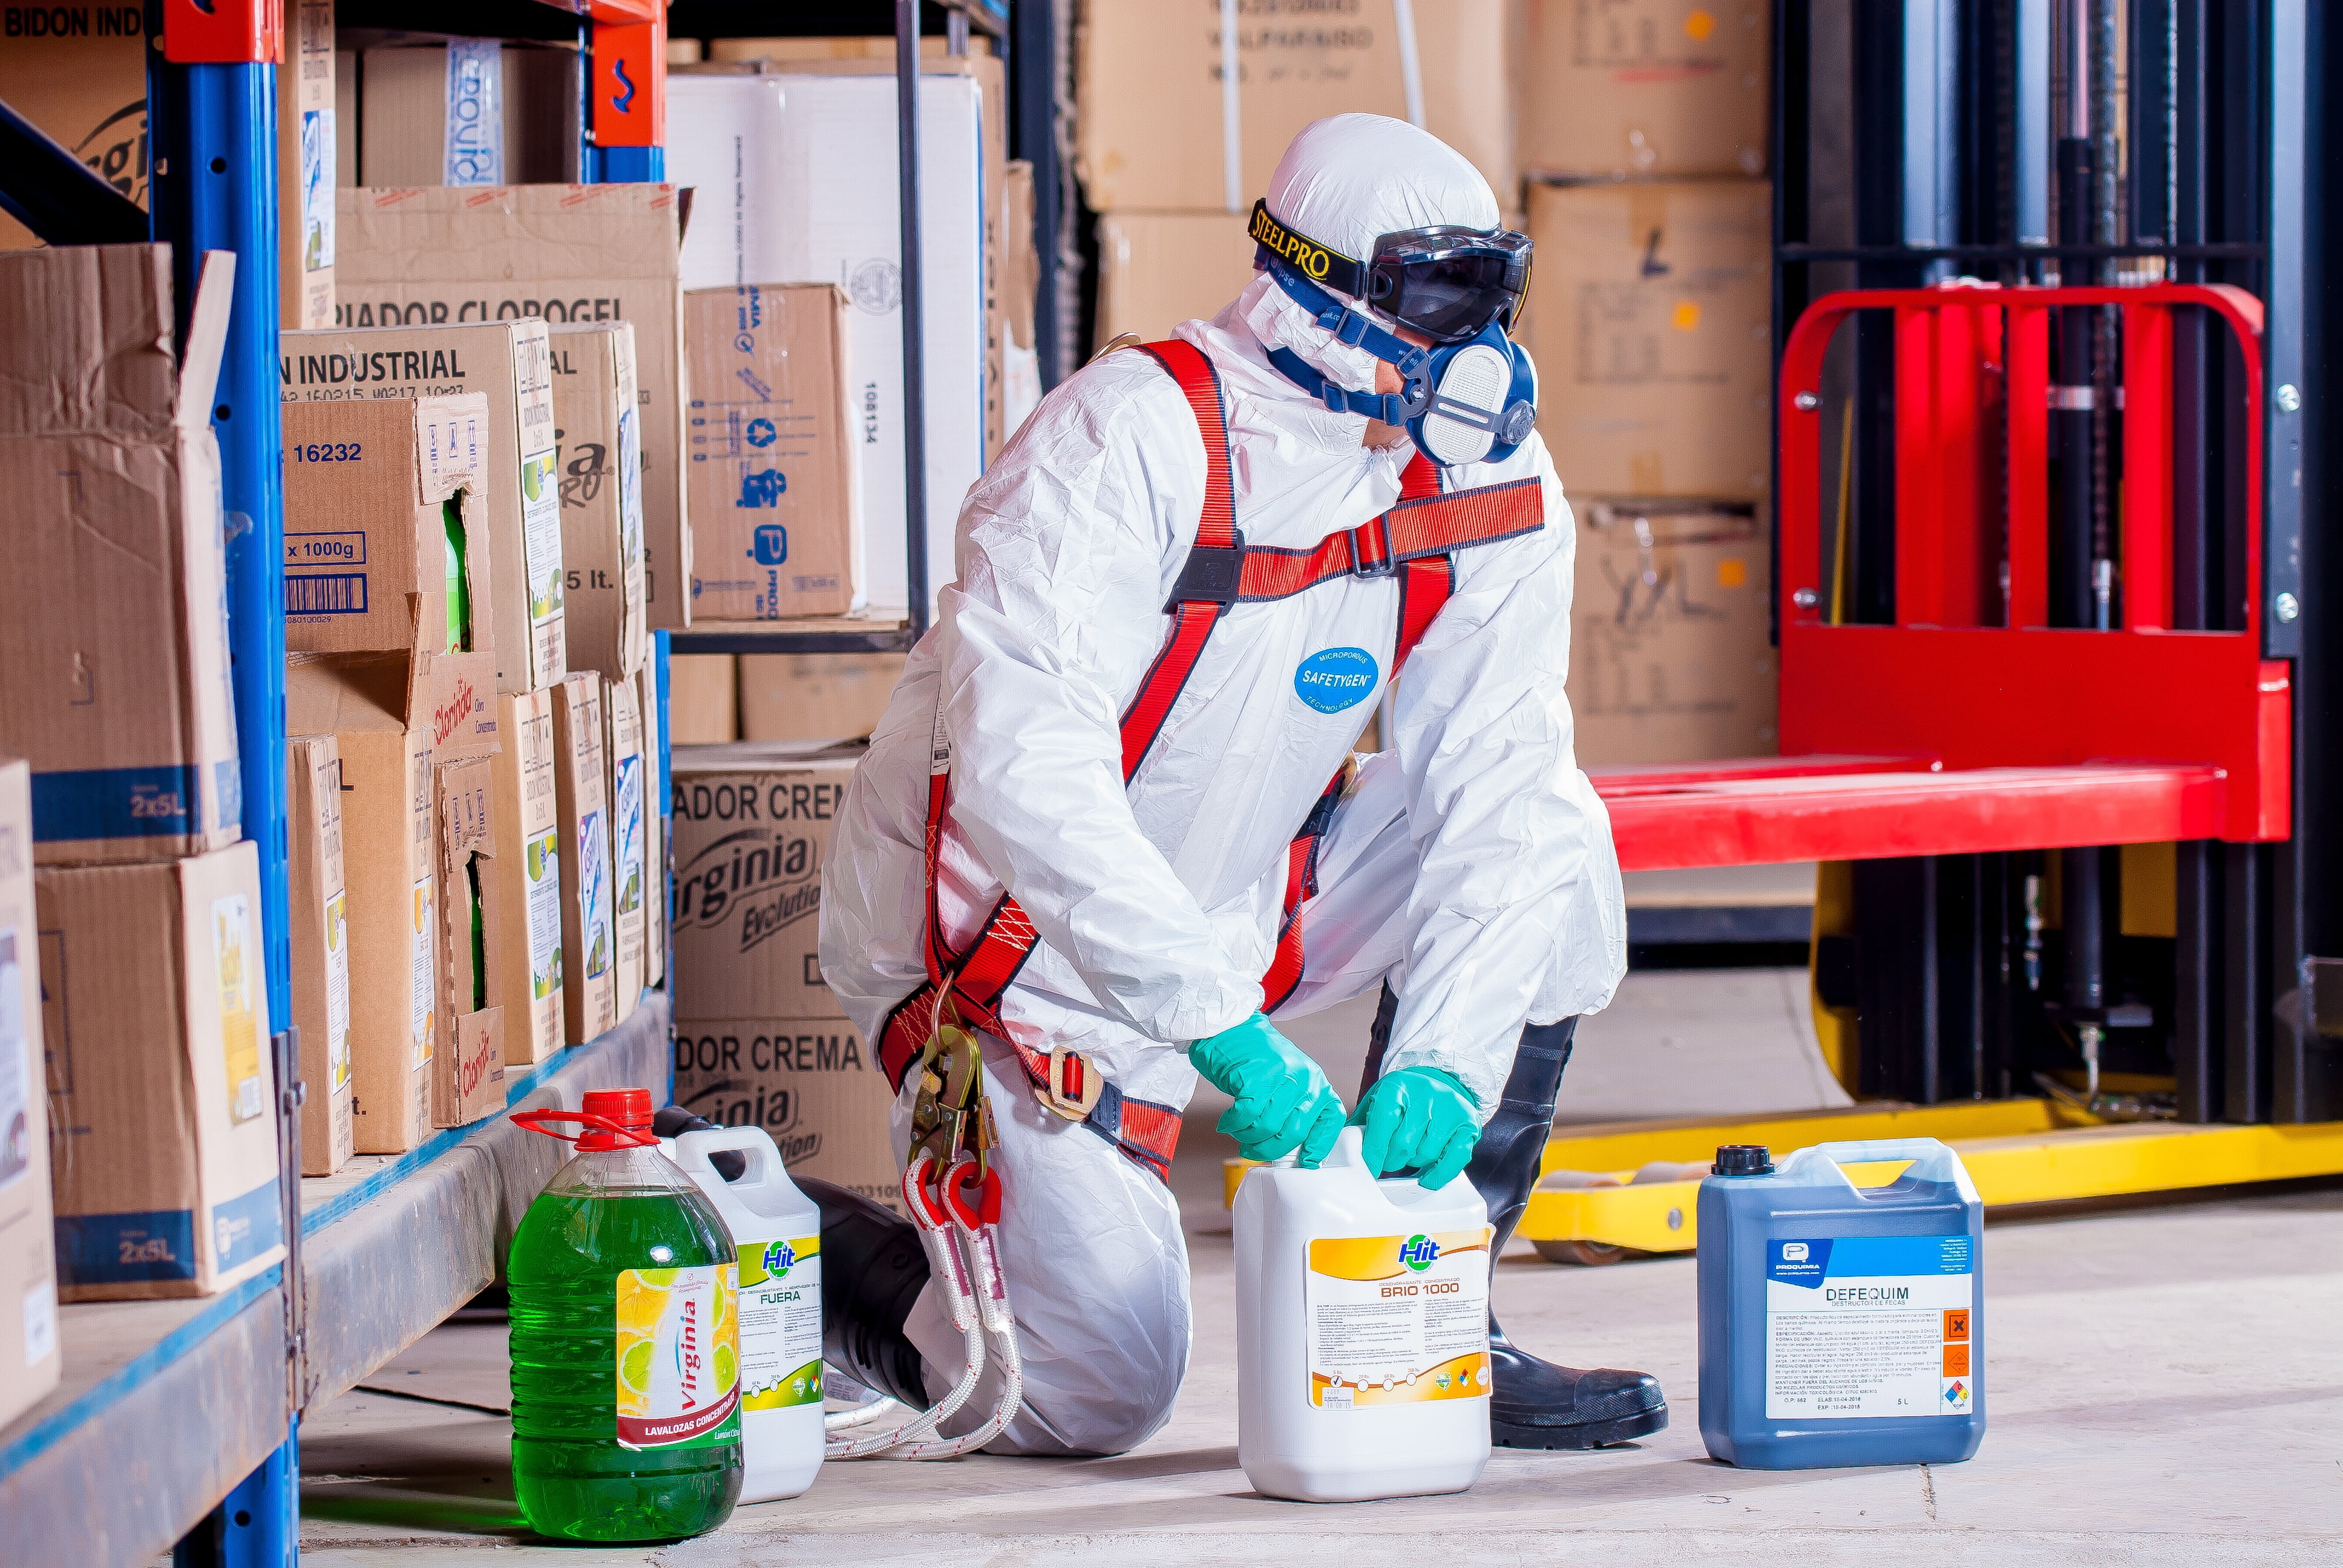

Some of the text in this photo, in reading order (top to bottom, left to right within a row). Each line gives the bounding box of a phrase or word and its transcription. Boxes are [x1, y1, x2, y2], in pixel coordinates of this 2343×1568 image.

[5, 7, 88, 37] BIDON
[1253, 209, 1329, 280] STEELPRO
[299, 349, 466, 384] INDUSTRIAL
[865, 379, 879, 443] 108134
[293, 442, 362, 463] 16232
[287, 542, 354, 558] x 1000g
[566, 569, 614, 590] 5 lt.
[1319, 652, 1368, 664] MICROPOROUS
[1302, 670, 1368, 687] SAFETYGEN
[434, 675, 473, 746] Clorinda
[1306, 695, 1354, 711] TECHNOLOGY
[675, 1035, 863, 1072] DOR CREMA
[762, 1244, 796, 1270] Hit
[1398, 1238, 1440, 1263] Hit
[760, 1290, 801, 1304] FUERA
[1381, 1282, 1460, 1298] BRIO 1000
[1826, 1287, 1909, 1301] DEFEQUIM
[681, 1299, 701, 1411] Virginia
[644, 1391, 735, 1436] LAVALOZAS CONCENTRADO
